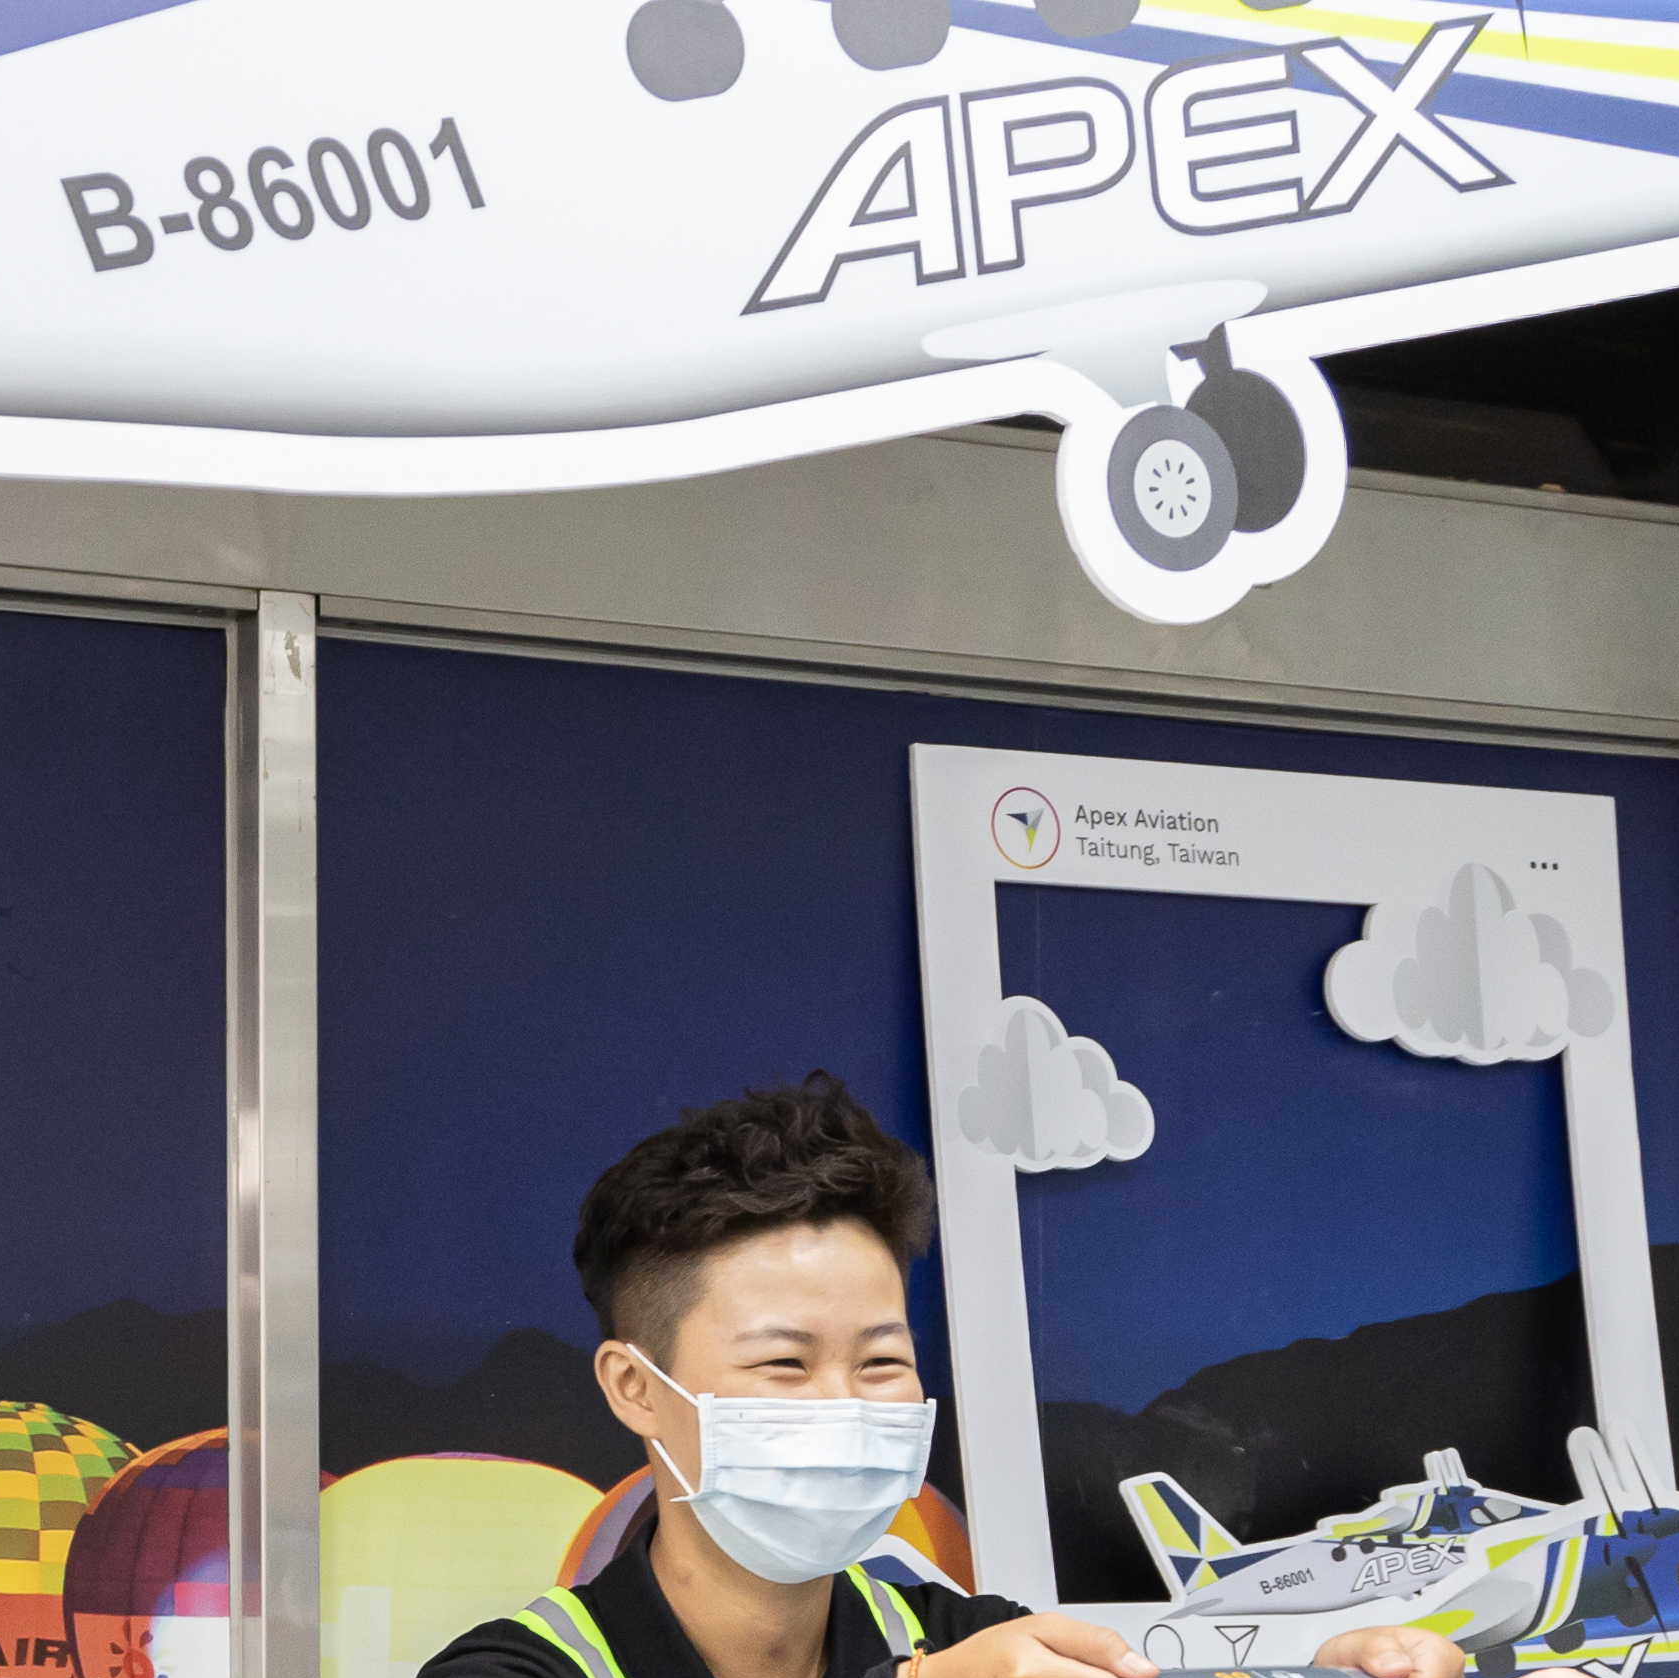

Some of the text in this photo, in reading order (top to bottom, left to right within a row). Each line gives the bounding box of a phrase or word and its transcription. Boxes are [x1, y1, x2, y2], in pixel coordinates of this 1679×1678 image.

[739, 13, 1517, 317] APEX
[61, 117, 487, 273] B-86001
[1075, 804, 1220, 833] Apex Aviation
[1076, 836, 1240, 867] Taitung, Taiwan
[1259, 1568, 1315, 1594] B-86001
[1350, 1536, 1464, 1593] APEX
